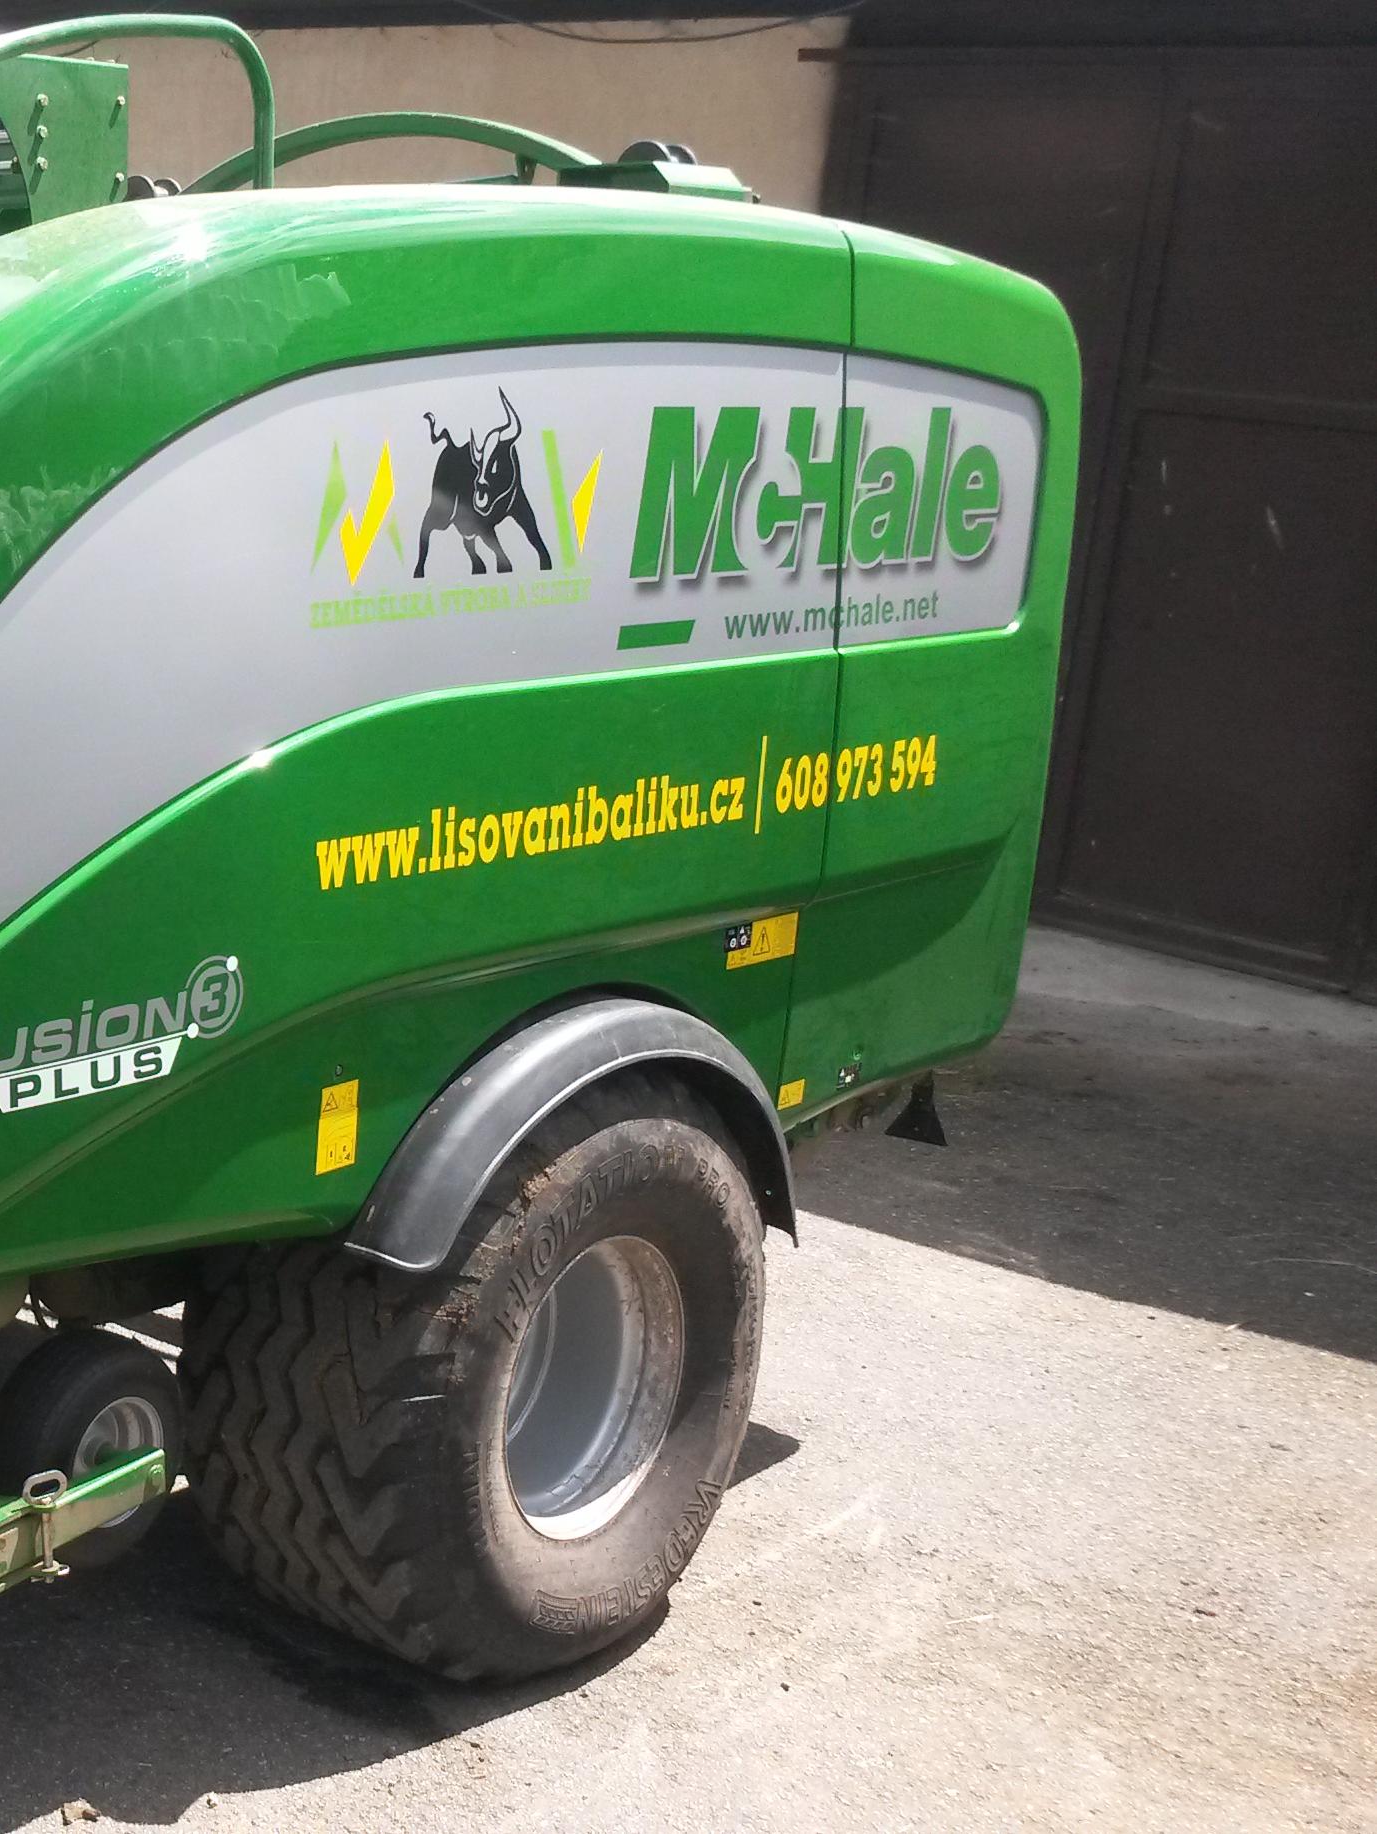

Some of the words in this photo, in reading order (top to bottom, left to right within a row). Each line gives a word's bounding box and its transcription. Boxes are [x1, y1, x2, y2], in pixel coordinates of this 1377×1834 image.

[628, 405, 1001, 580] McHale
[723, 592, 939, 639] www.mchale.net
[316, 775, 746, 891] www.lisovanibaliku.cz
[775, 753, 830, 815] 608
[836, 745, 884, 803] 973
[889, 735, 938, 794] 594
[9, 1046, 164, 1109] PLUS
[577, 1478, 723, 1636] VREDESTEIN
